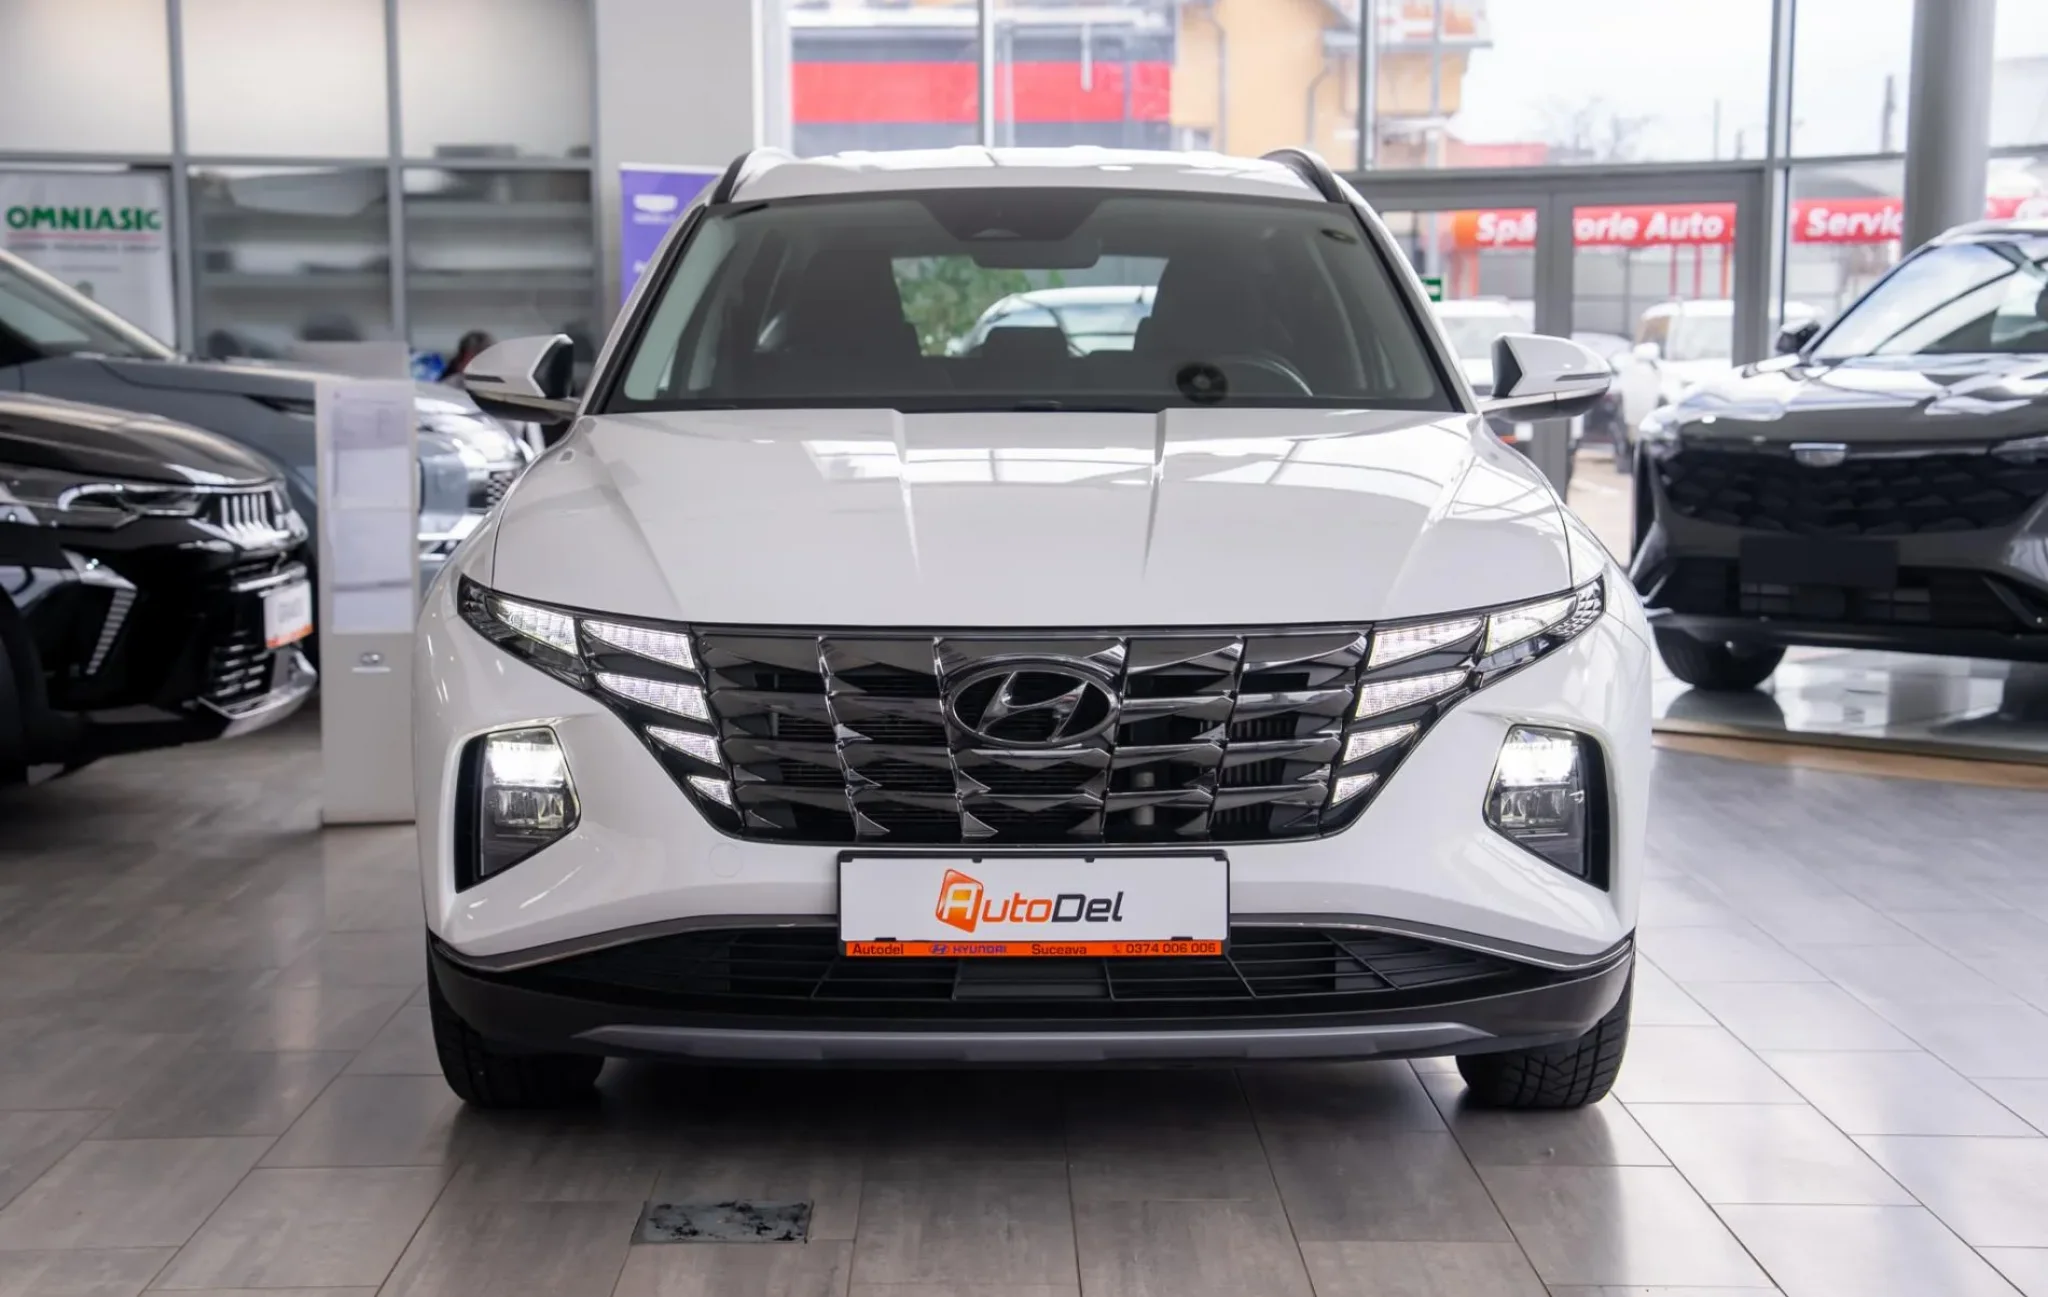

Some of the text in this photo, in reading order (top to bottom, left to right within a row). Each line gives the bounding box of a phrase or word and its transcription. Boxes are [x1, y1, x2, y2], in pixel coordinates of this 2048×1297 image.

[1644, 210, 1725, 240] Auto
[1805, 205, 1904, 237] Servic
[941, 881, 1125, 923] AutoDel
[852, 942, 904, 955] Autodel
[952, 944, 1007, 954] HYUNDAI
[1031, 942, 1087, 955] Suceava
[1125, 943, 1159, 954] 0374
[1163, 942, 1187, 954] 006
